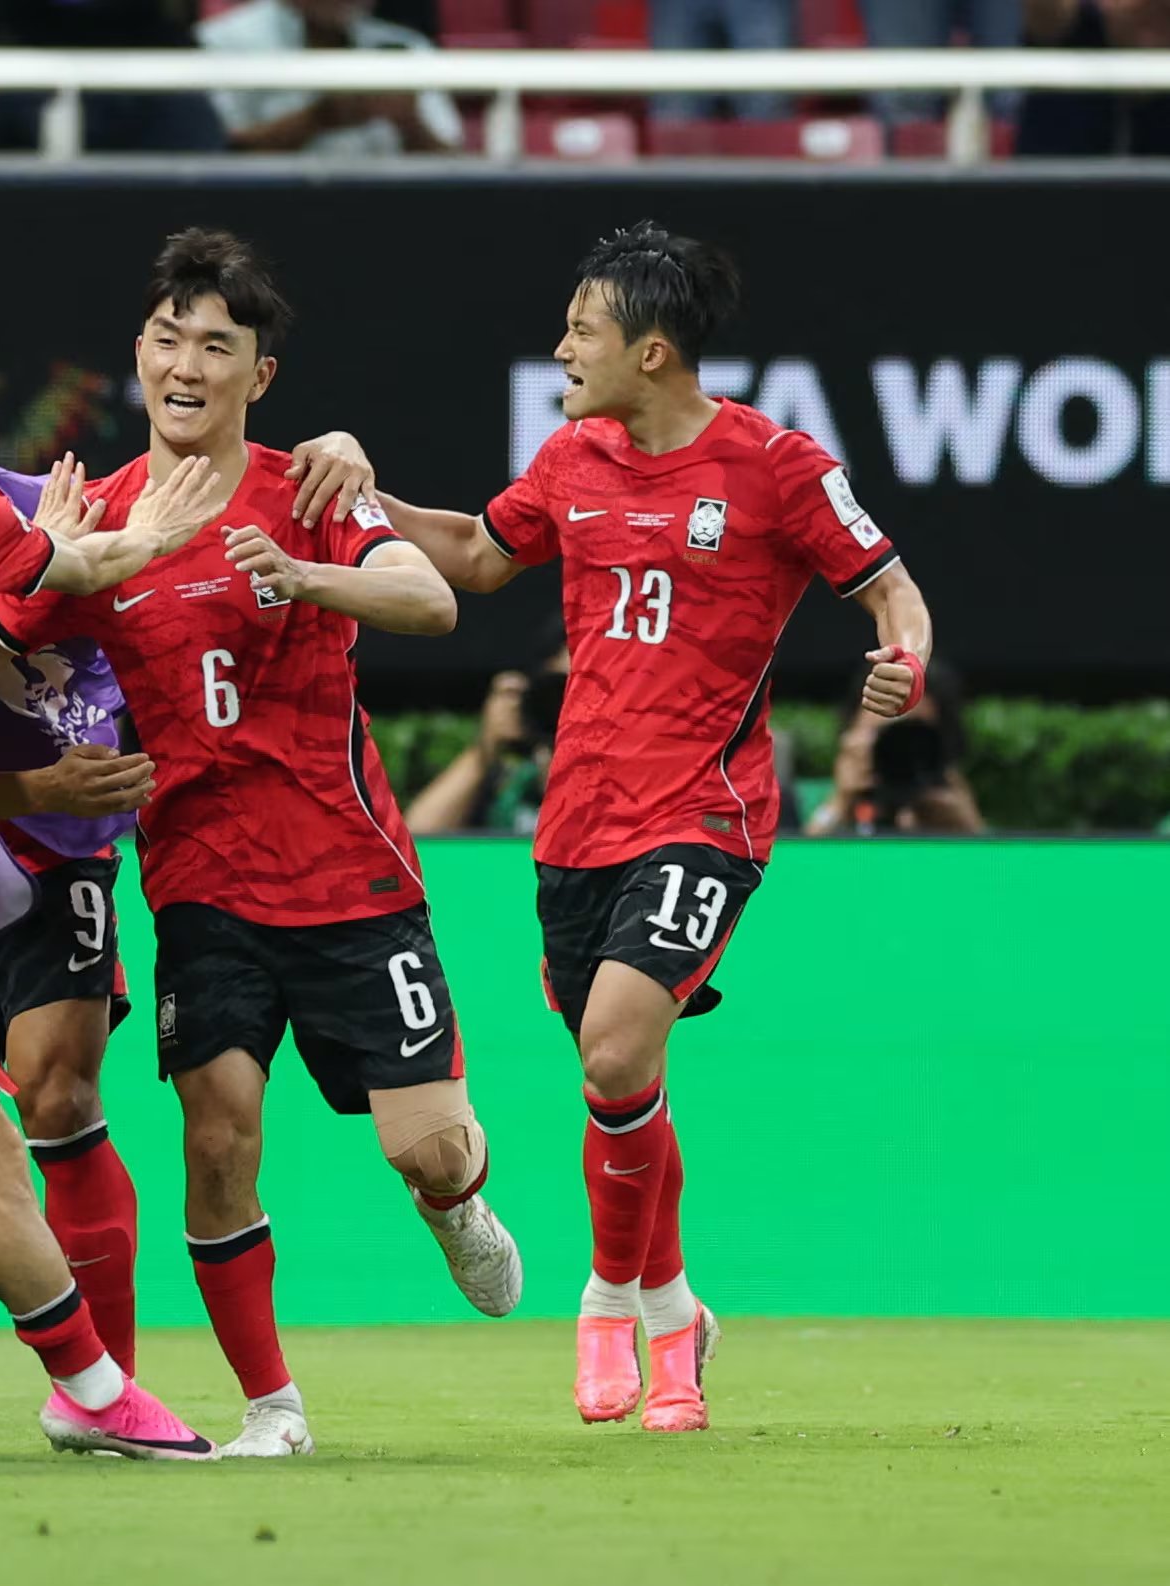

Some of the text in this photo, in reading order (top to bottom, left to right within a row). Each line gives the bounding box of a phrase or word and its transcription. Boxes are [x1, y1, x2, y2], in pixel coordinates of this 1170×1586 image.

[605, 566, 673, 645] 13
[201, 648, 240, 728] 6
[70, 880, 106, 951] 9
[645, 863, 728, 951] 13
[388, 950, 438, 1030] 6
